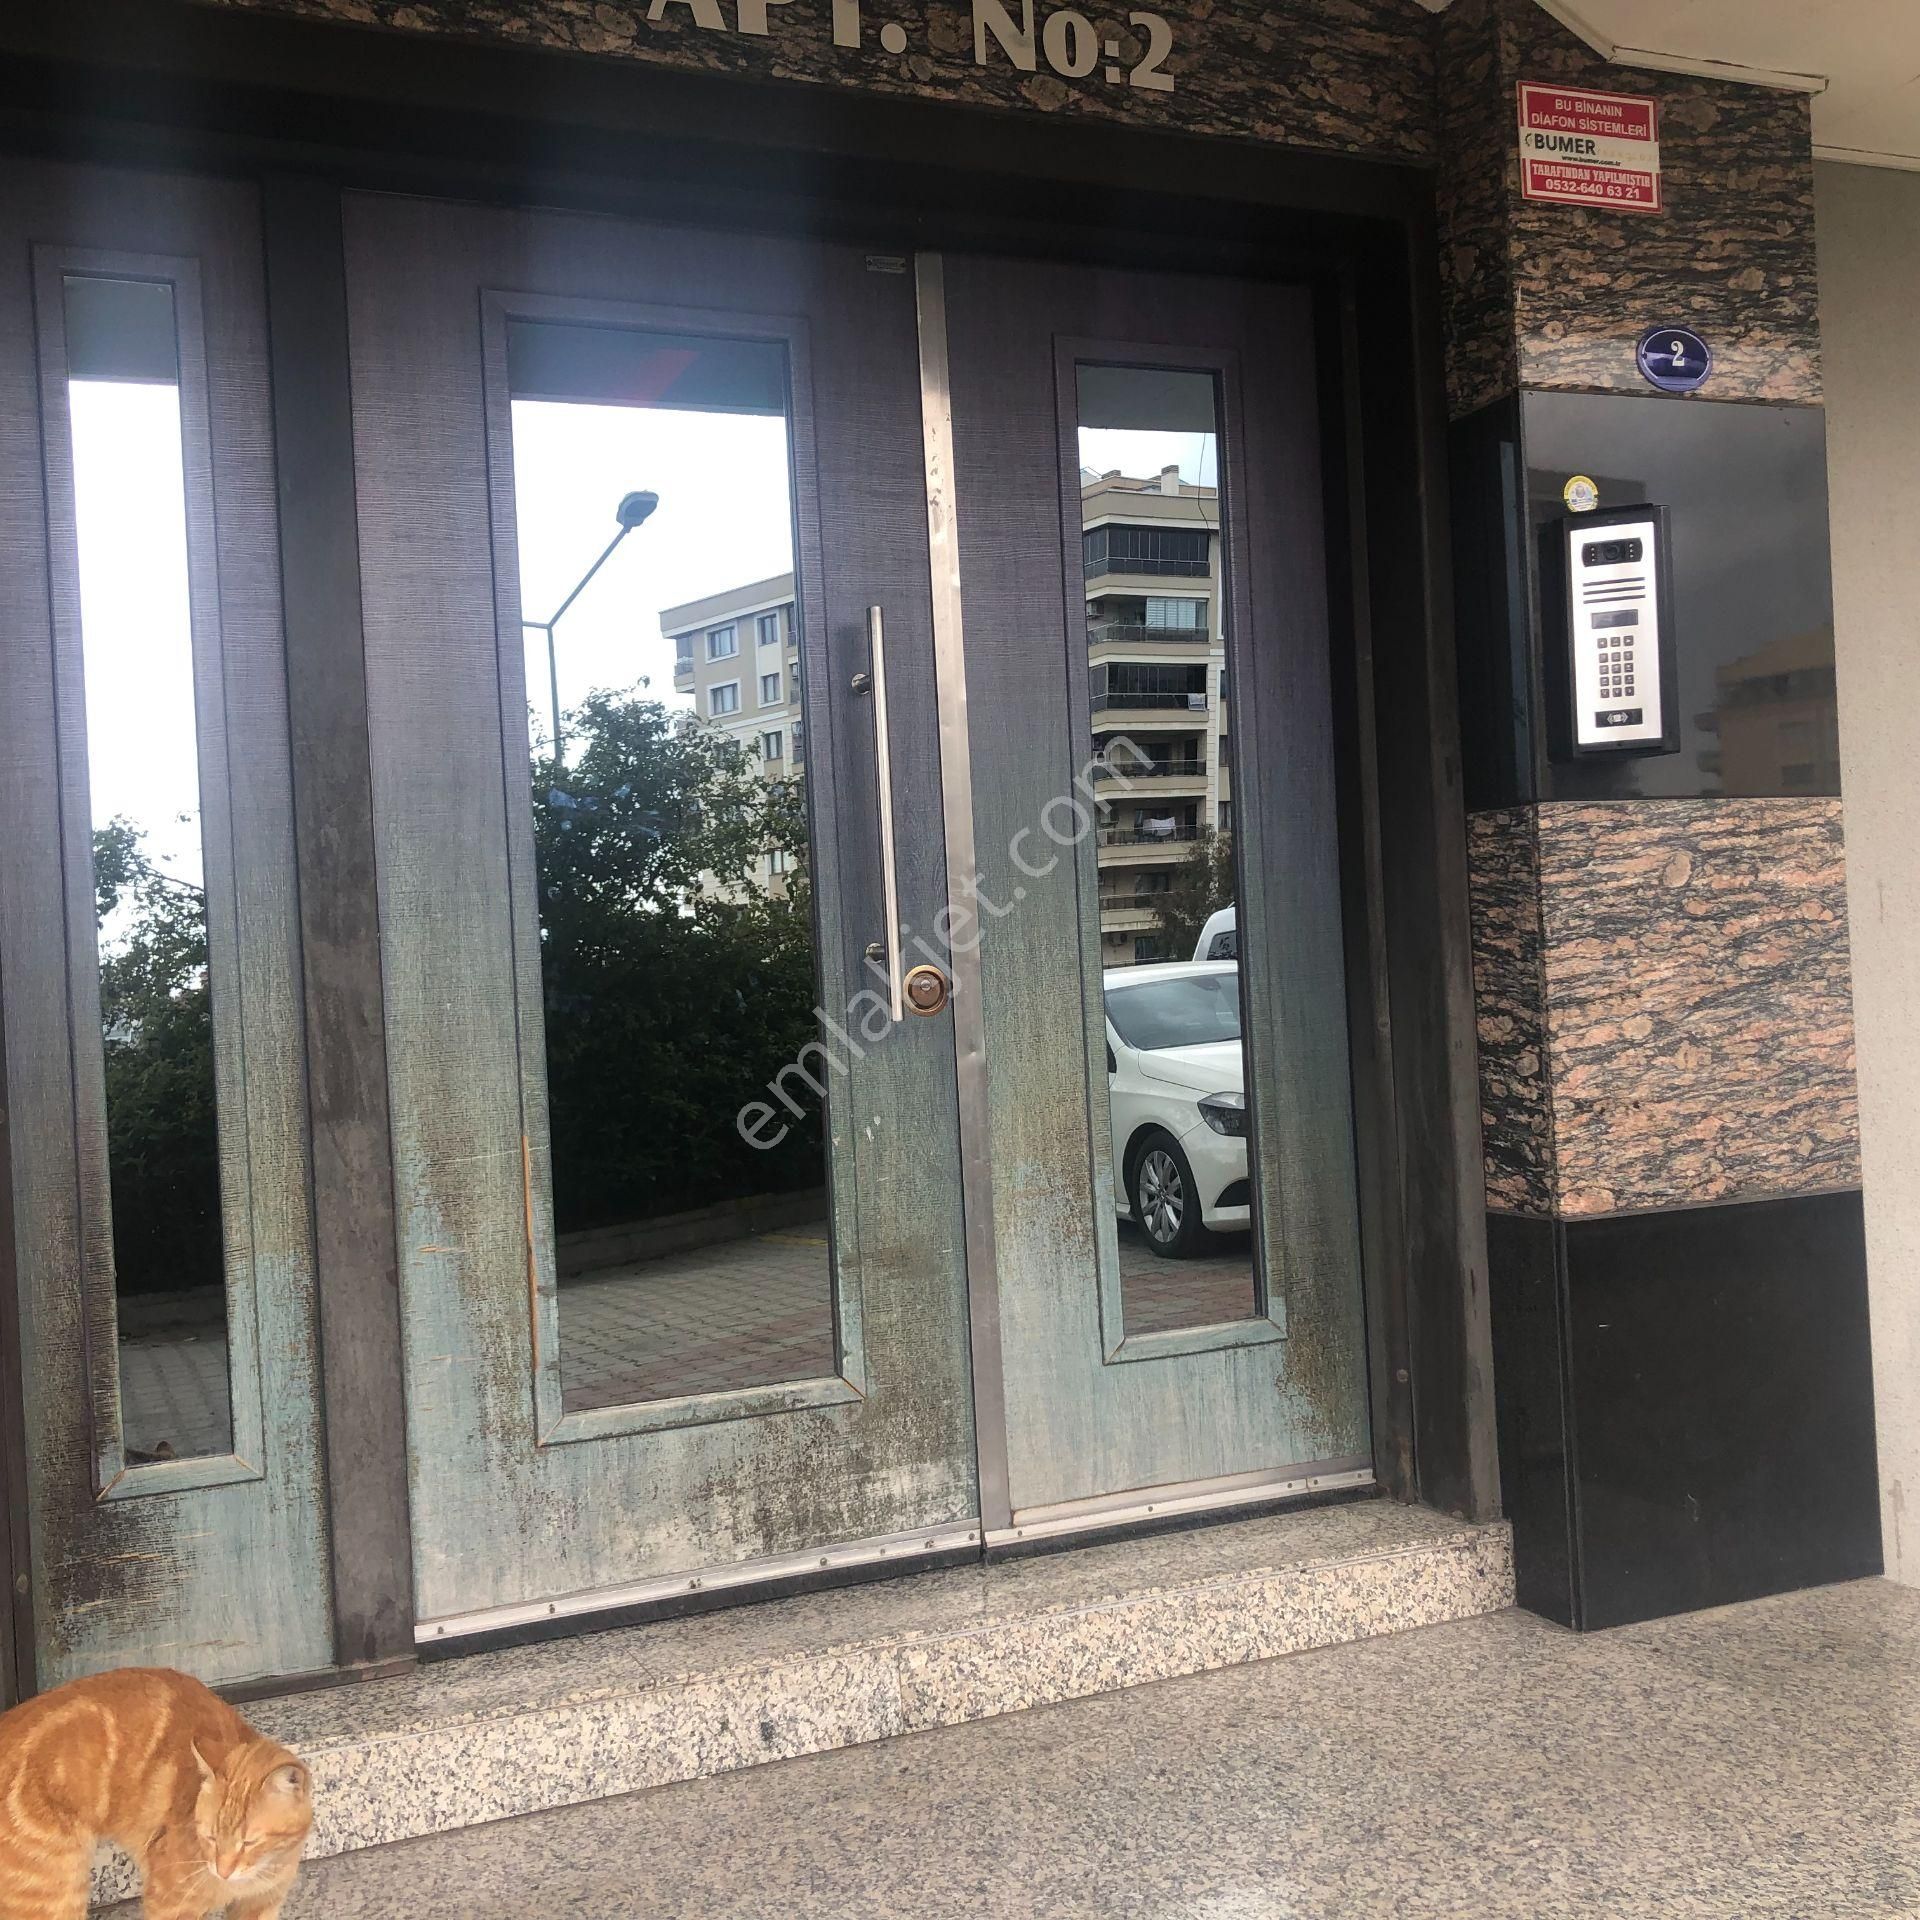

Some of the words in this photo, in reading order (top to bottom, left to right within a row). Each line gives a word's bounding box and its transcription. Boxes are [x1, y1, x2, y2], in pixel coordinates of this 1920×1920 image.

[1555, 99, 1572, 111] BU
[1575, 100, 1622, 117] BİNANIN
[1531, 112, 1576, 129] DİAFON
[1579, 118, 1647, 137] SİSTEMLERİ
[1534, 133, 1596, 155] BUMER
[1532, 163, 1591, 181] TARAFINDAN
[1545, 178, 1603, 195] 0532-640
[1606, 186, 1622, 197] 63
[1625, 188, 1640, 199] 21
[1671, 341, 1685, 367] 2
